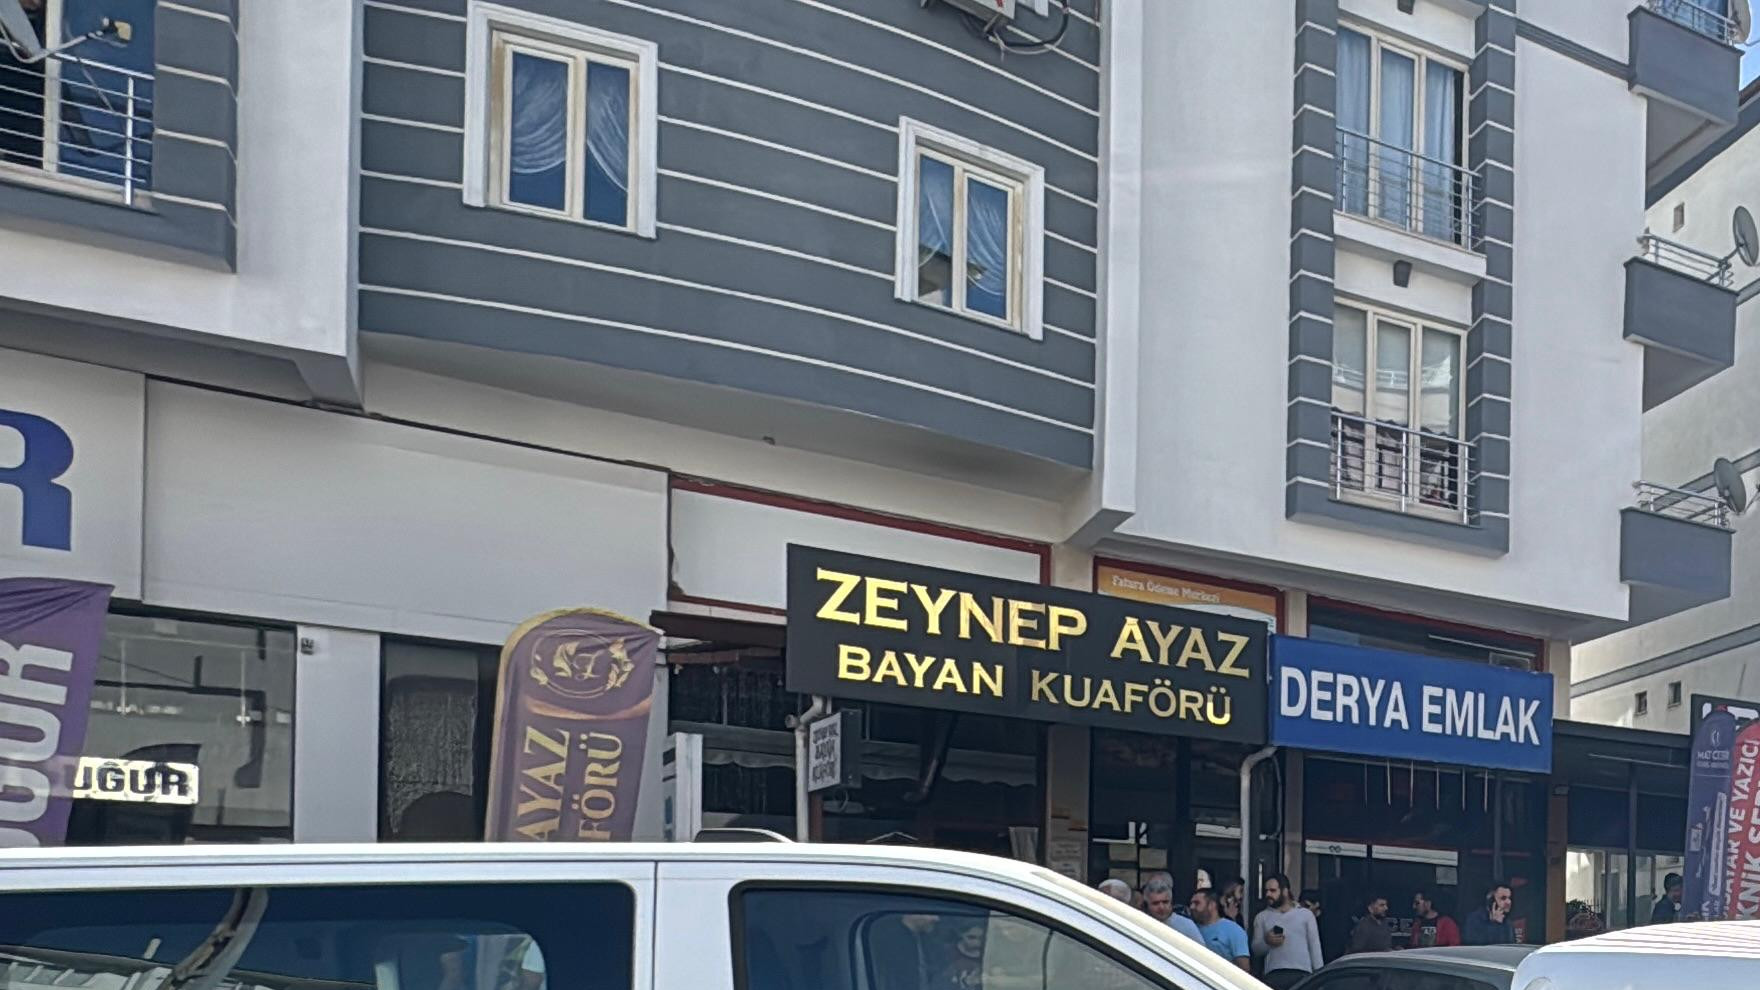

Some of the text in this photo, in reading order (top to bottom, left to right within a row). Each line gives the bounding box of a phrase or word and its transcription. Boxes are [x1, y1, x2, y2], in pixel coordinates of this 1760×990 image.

[815, 567, 1251, 679] ZEYNEP AYAZ
[837, 643, 1232, 726] BAYAN KUAFÖRÜ
[1280, 665, 1541, 746] DERYA EMLAK
[515, 725, 571, 841] AYAZ
[1728, 806, 1746, 834] VE
